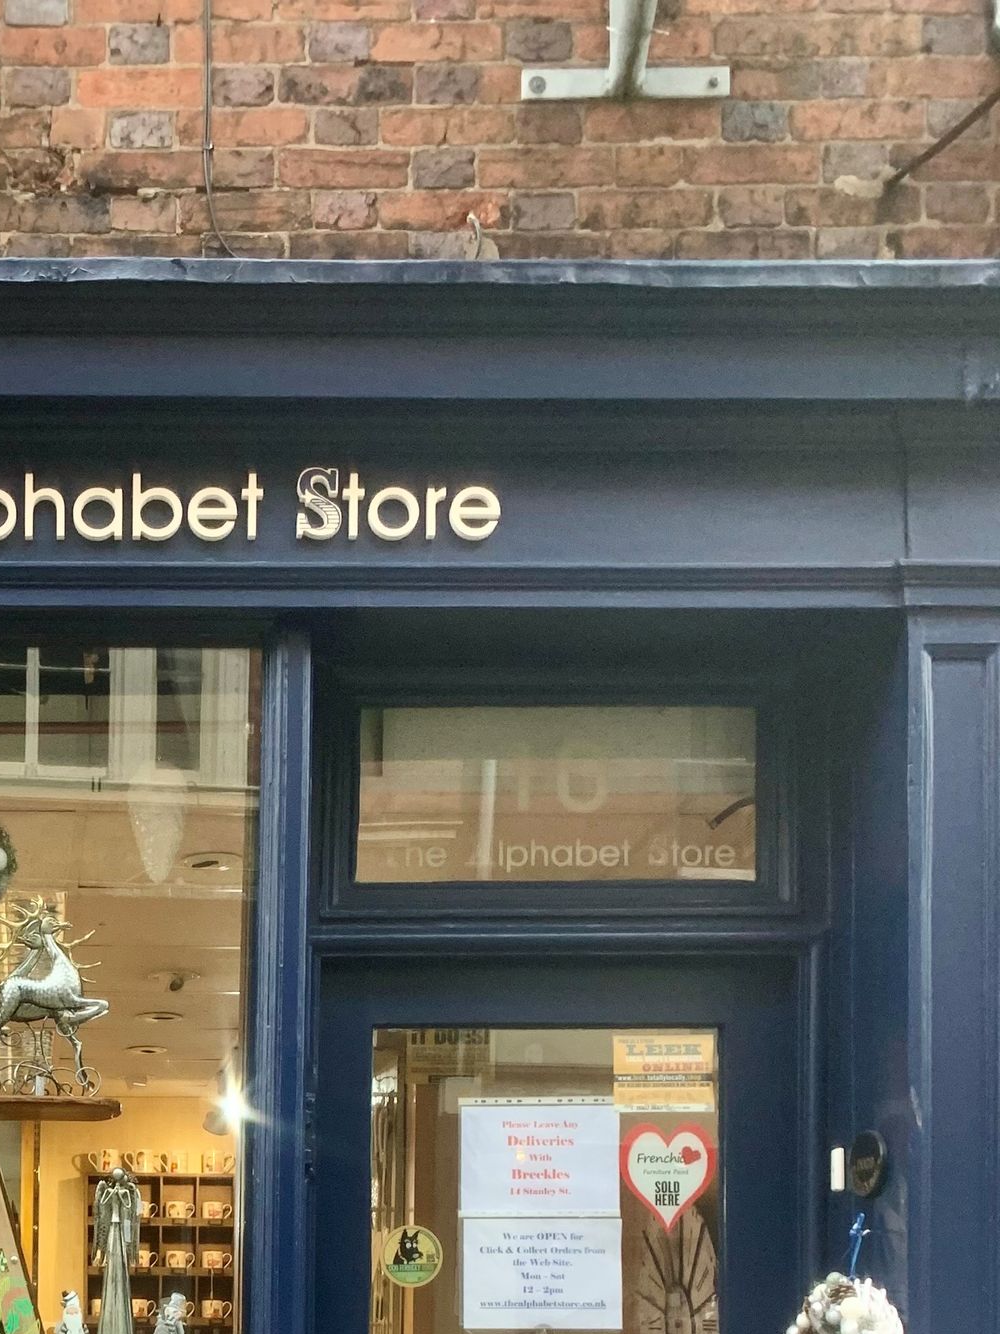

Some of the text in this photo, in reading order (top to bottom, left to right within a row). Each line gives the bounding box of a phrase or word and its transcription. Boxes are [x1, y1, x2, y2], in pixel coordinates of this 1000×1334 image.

[296, 466, 502, 541] Store
[625, 1044, 702, 1056] LEEK
[502, 1120, 579, 1130] Please Leave Any
[507, 1135, 575, 1147] Deliveries
[529, 1153, 552, 1162] With
[654, 1180, 681, 1194] SOLD
[654, 1193, 681, 1207] HERE
[536, 1232, 567, 1240] OPEN
[520, 1272, 541, 1280] Mon
